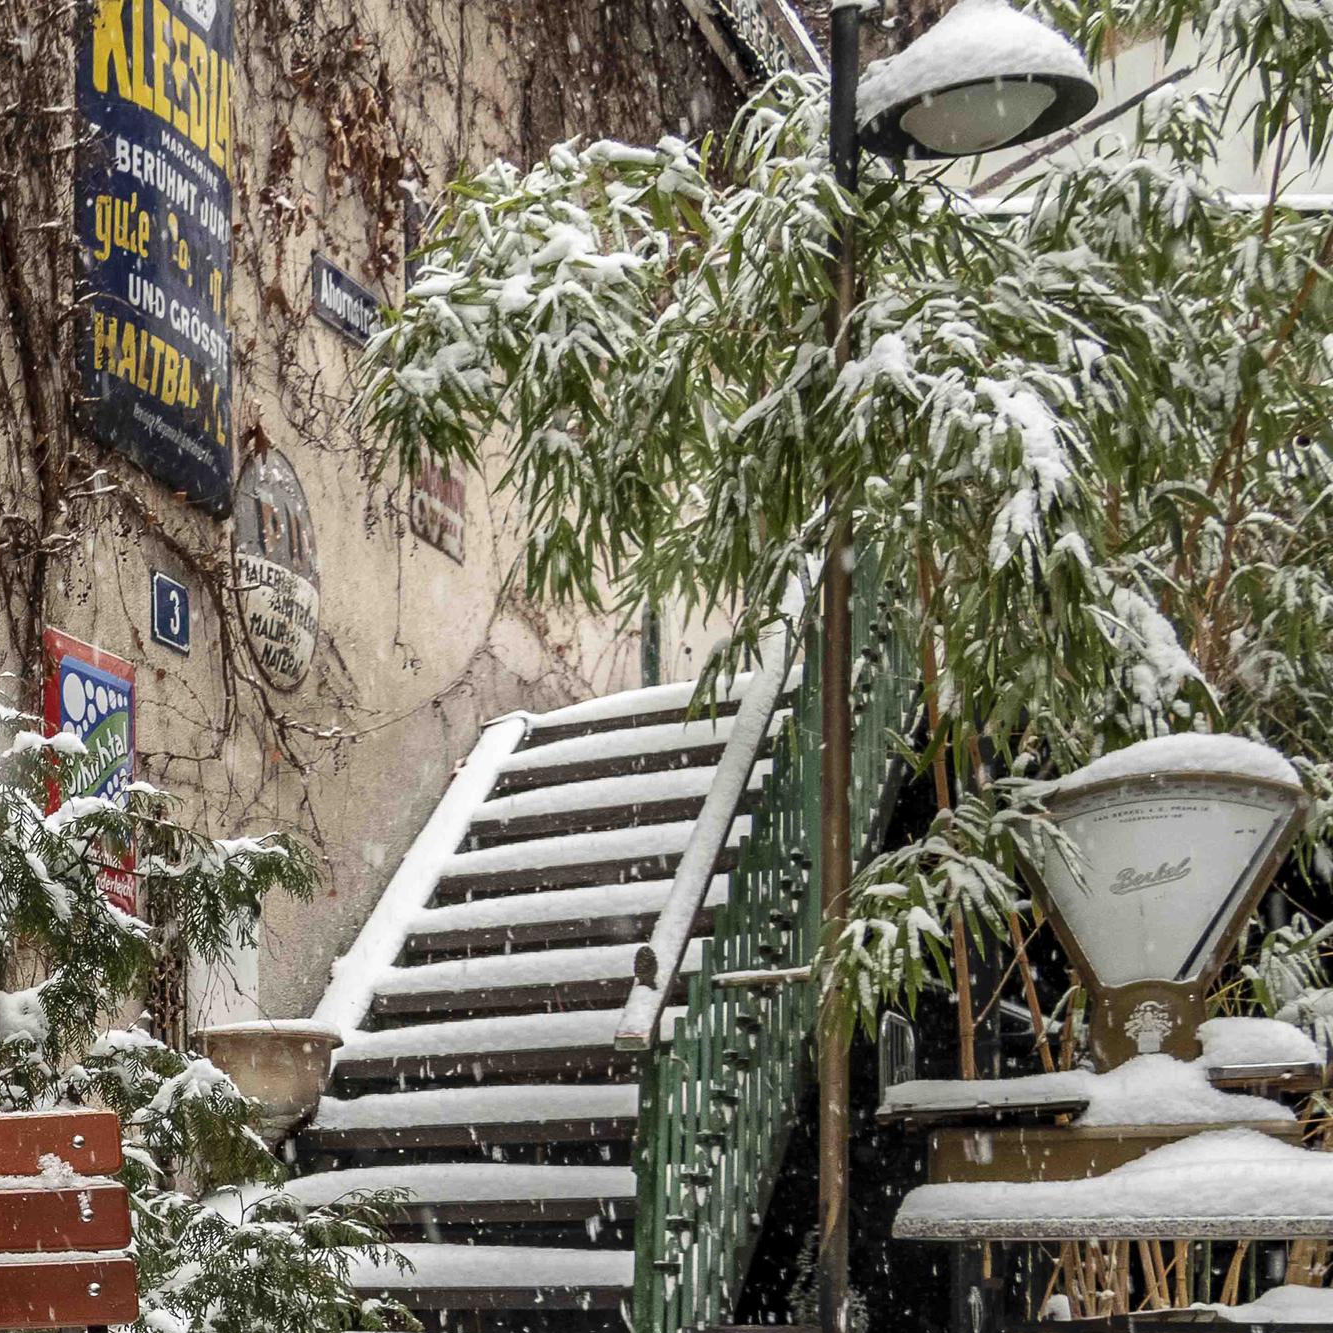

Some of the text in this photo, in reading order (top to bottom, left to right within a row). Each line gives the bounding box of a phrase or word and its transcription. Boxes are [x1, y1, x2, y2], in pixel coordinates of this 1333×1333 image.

[115, 136, 198, 216] BERÜHMT
[161, 130, 219, 193] MARGARINE
[129, 273, 165, 319] UND
[169, 590, 180, 635] 3
[1109, 857, 1192, 896] Berkel
